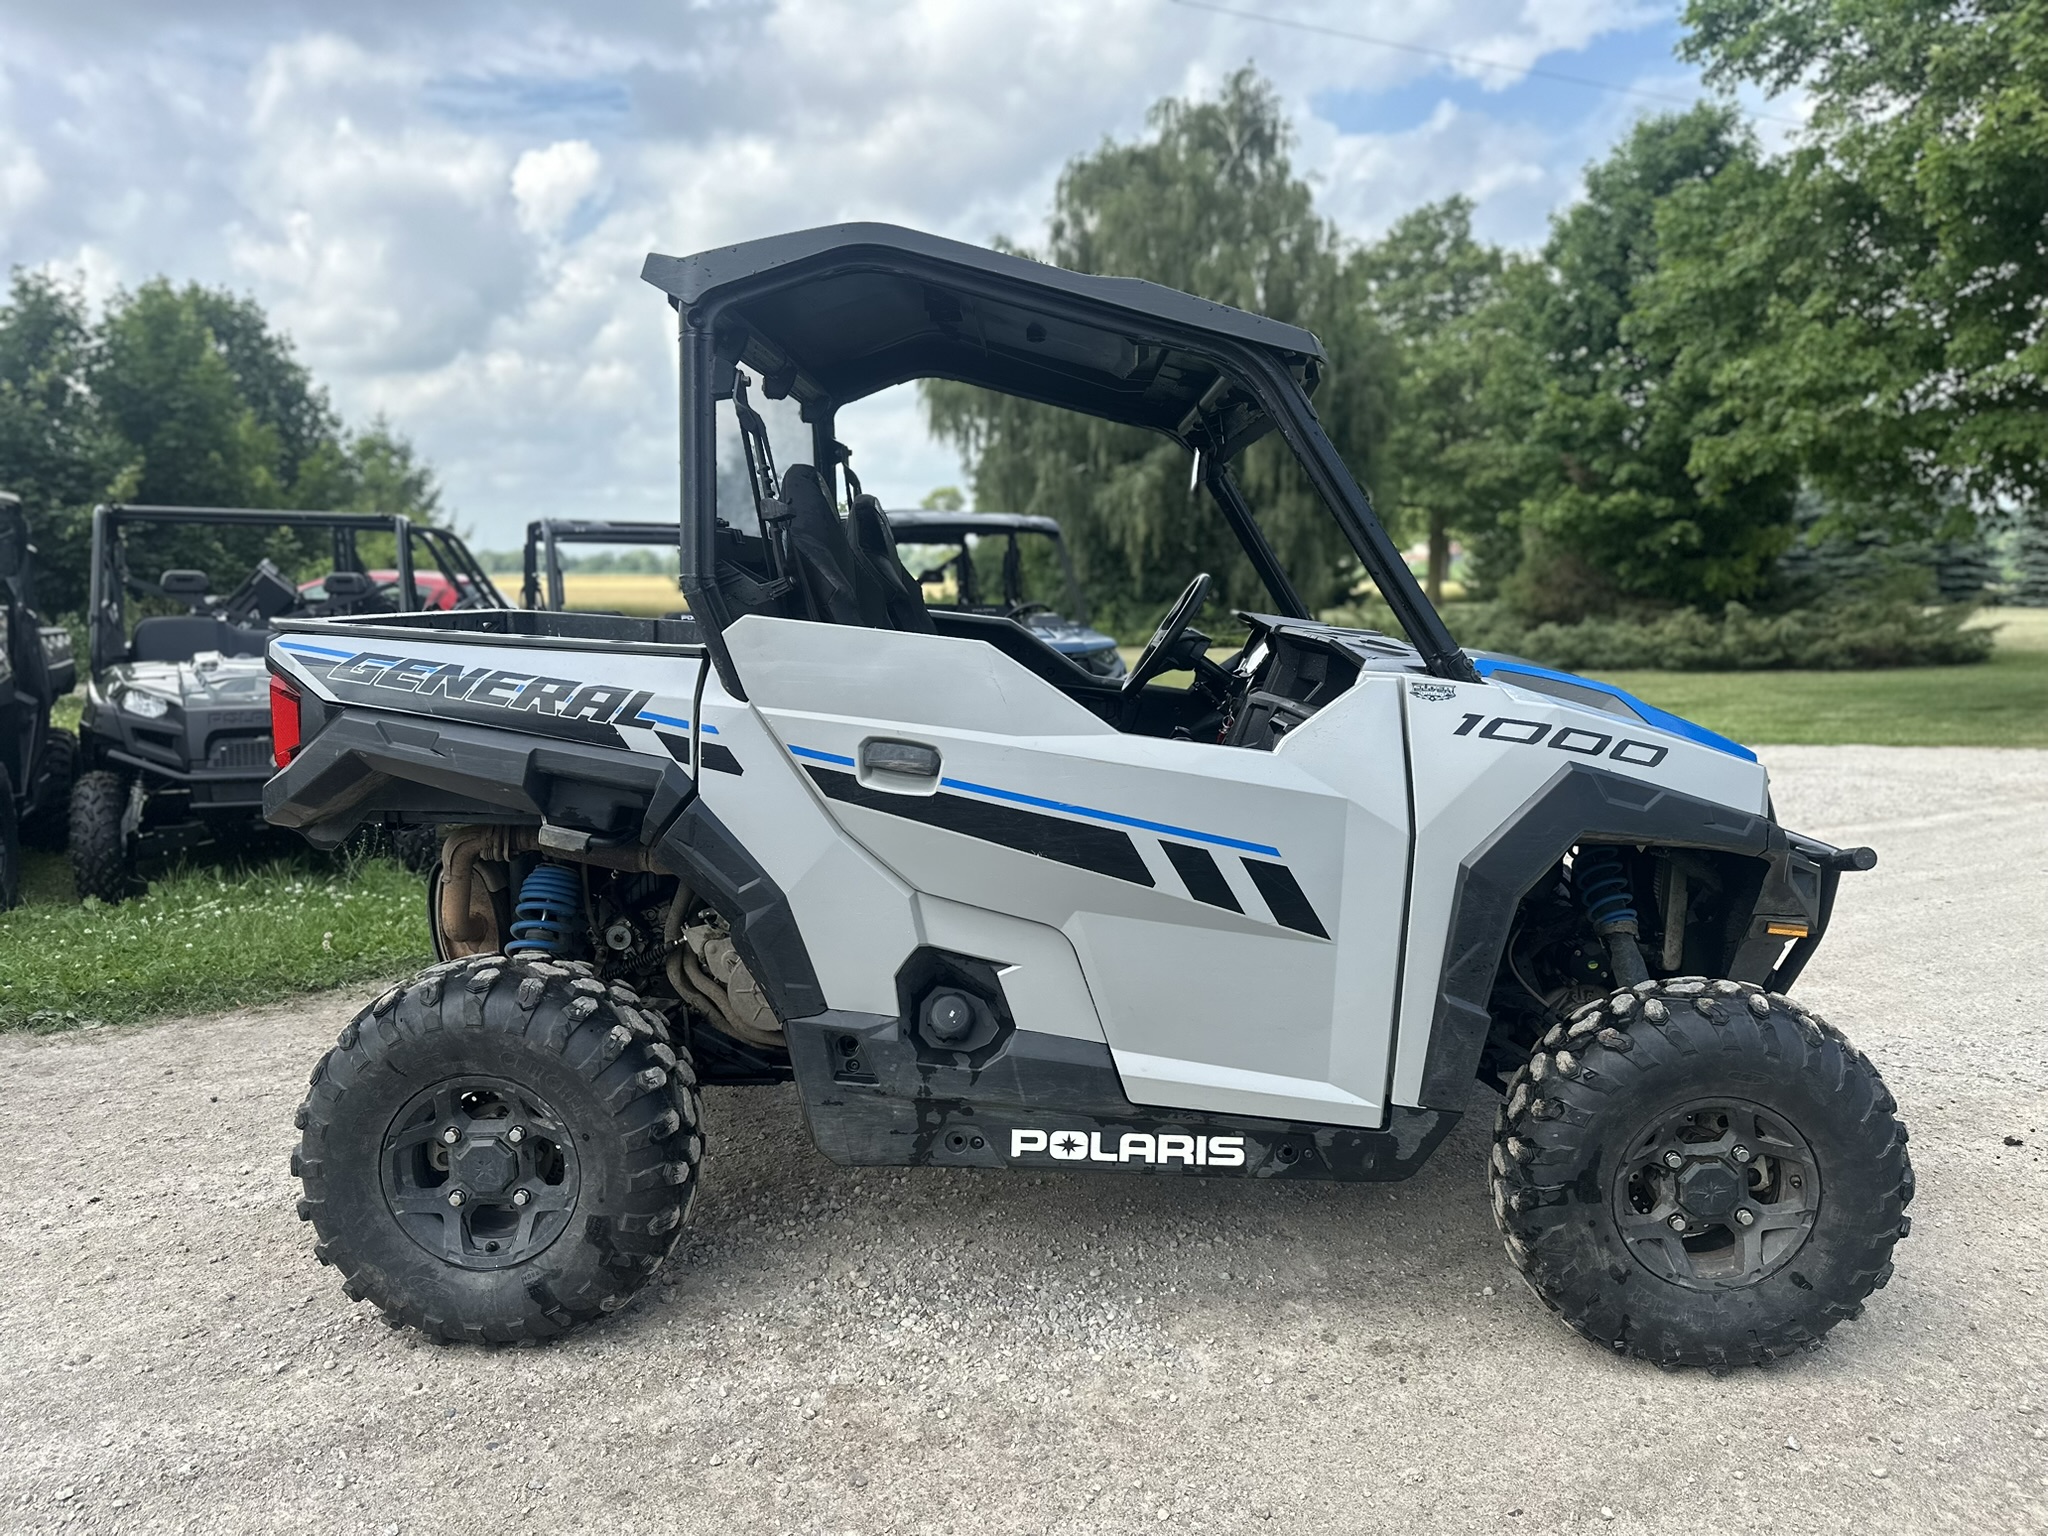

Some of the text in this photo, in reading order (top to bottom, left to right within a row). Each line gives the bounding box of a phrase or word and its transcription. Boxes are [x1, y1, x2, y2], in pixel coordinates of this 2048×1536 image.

[327, 651, 657, 730] GENERAL
[1453, 713, 1669, 767] 1000
[1011, 1129, 1245, 1166] POLARIS
